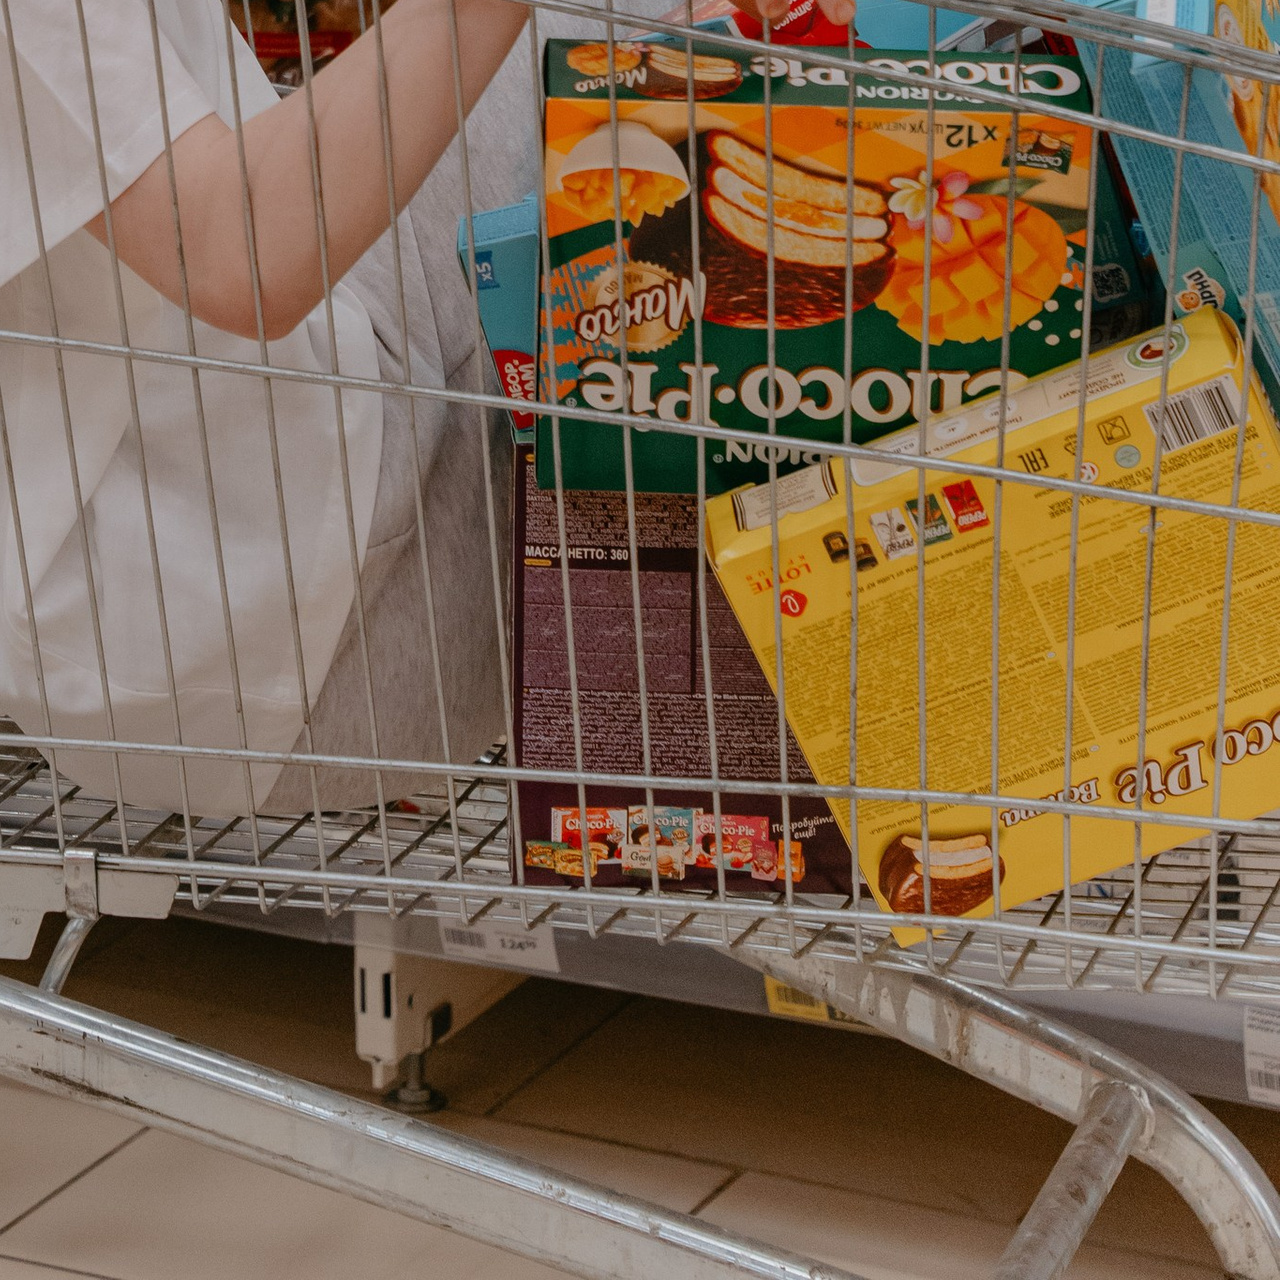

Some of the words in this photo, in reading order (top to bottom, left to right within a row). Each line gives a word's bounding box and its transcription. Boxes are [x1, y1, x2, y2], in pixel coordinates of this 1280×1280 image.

[602, 272, 643, 294] MAGO
[724, 437, 829, 464] RION
[610, 549, 629, 561] 360
[1108, 738, 1217, 818] Pie
[772, 814, 835, 833] Поробуйте
